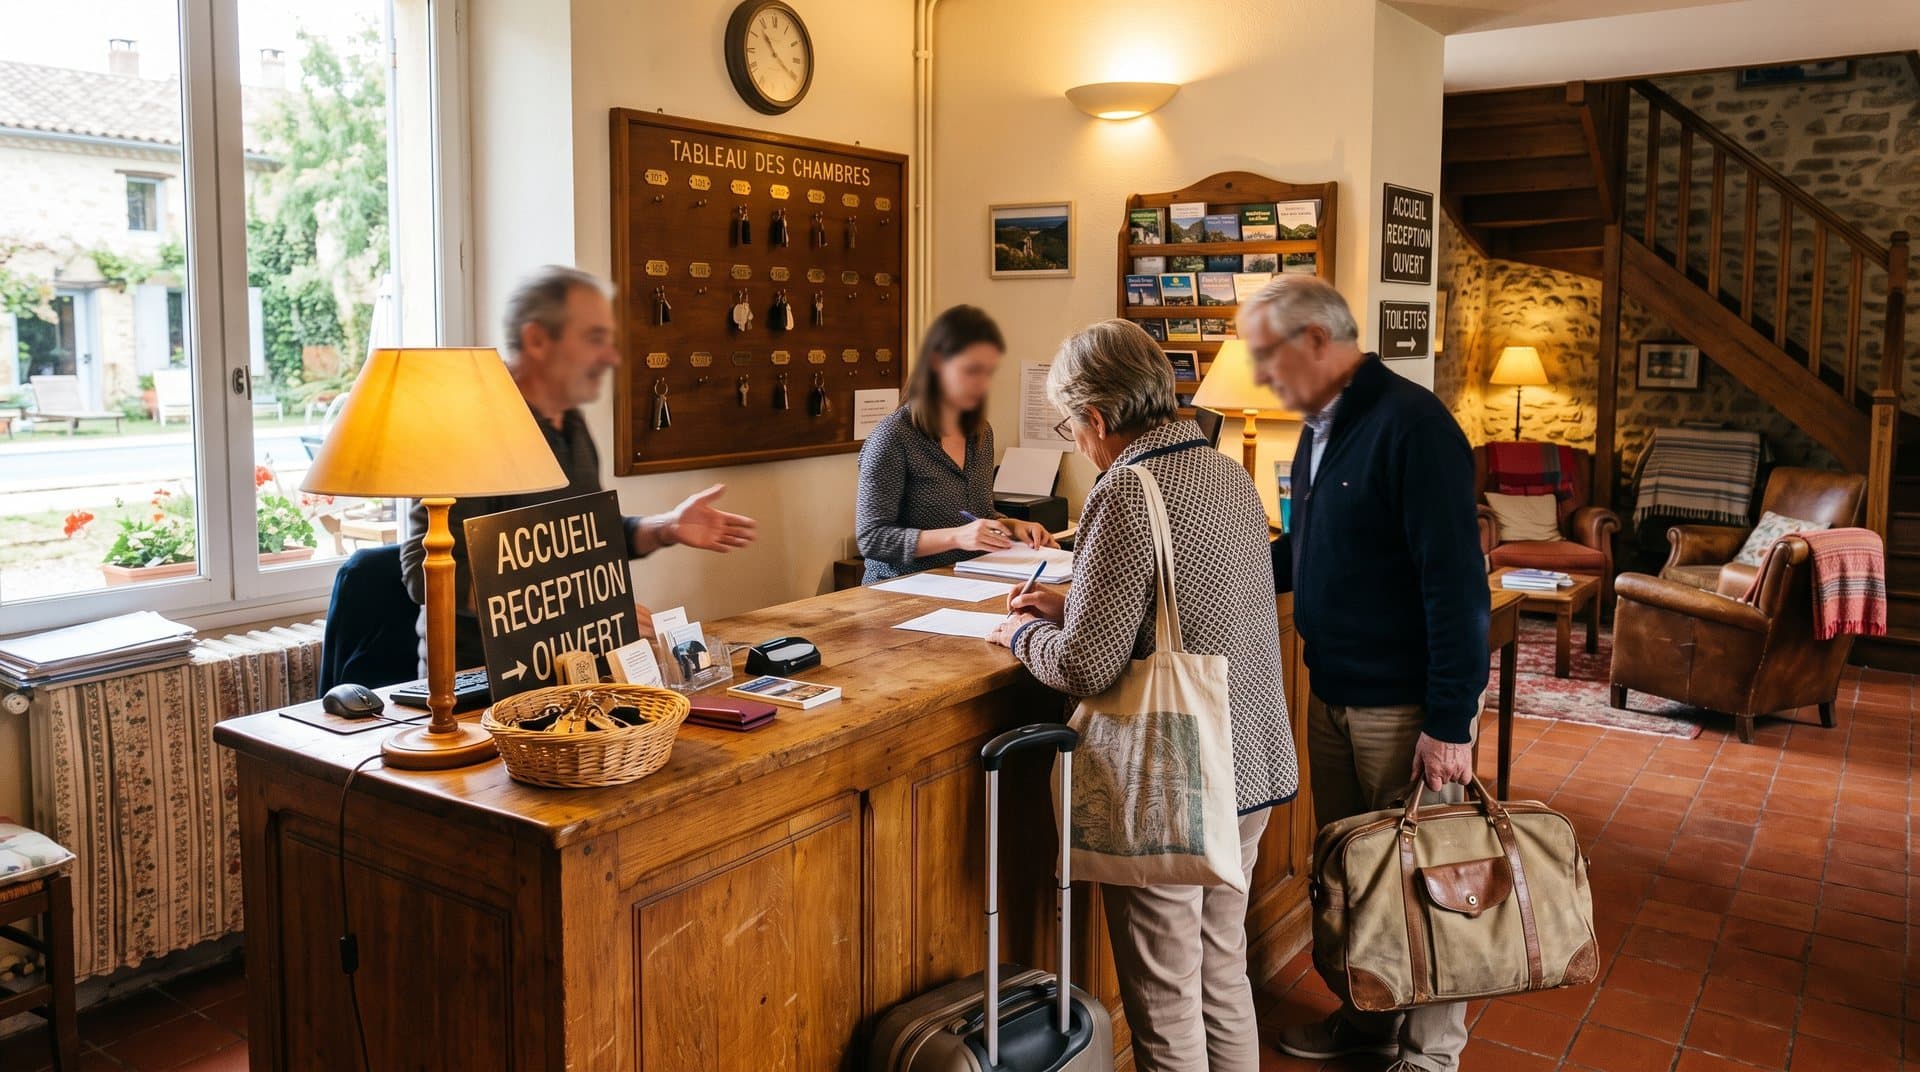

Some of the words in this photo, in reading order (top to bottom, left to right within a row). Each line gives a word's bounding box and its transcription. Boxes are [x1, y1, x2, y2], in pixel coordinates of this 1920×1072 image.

[670, 139, 747, 170] TABLEAU
[755, 152, 785, 175] DES
[792, 158, 871, 187] CHAMBRES
[1392, 196, 1427, 221] ACCUEIL
[1386, 223, 1431, 249] RECEPTION
[1392, 252, 1425, 275] OUVERT
[1385, 310, 1427, 330] TOILETTES
[497, 511, 607, 575] ACCUEIL
[488, 559, 627, 638] RECEPTION
